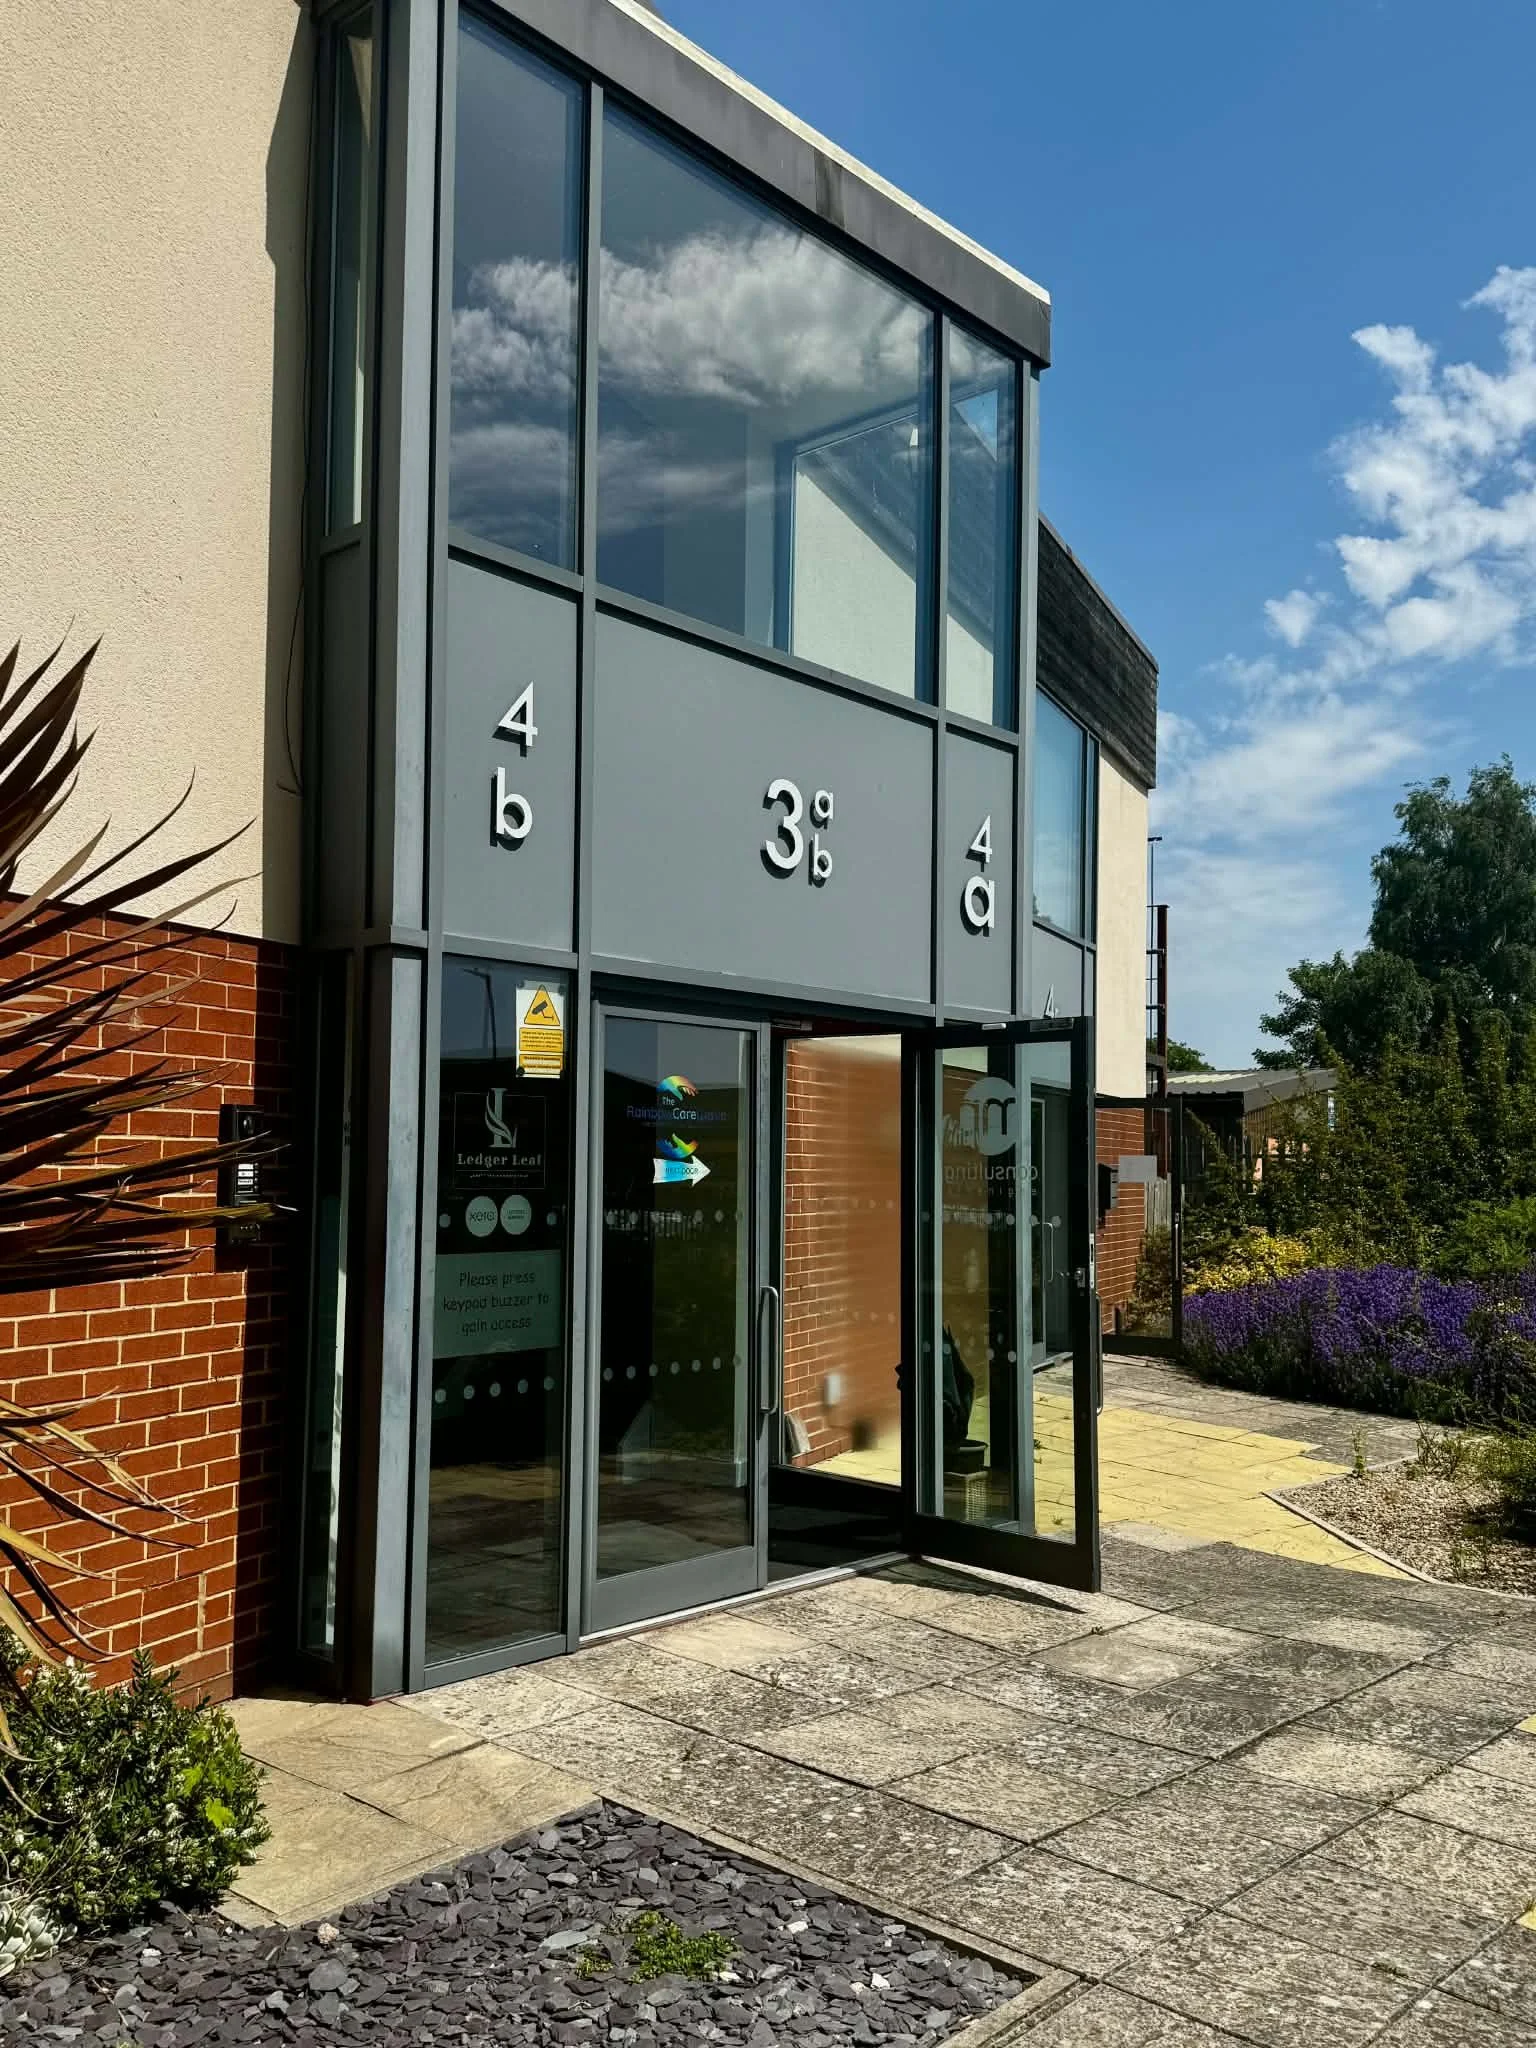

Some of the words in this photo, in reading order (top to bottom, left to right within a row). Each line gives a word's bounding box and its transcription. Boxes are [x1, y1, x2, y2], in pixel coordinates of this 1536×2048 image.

[498, 681, 538, 747] 4
[496, 766, 533, 840] b
[814, 789, 834, 822] a
[765, 778, 804, 871] 3
[969, 815, 993, 864] 4
[813, 833, 833, 880] b
[964, 875, 995, 929] a
[662, 1096, 676, 1106] The
[456, 1152, 508, 1169] Ledger
[512, 1153, 542, 1167] Leaf
[459, 1271, 498, 1288] Please
[502, 1271, 536, 1289] press
[443, 1295, 487, 1313] keypad
[491, 1295, 533, 1308] buzzer
[537, 1293, 550, 1305] to
[461, 1318, 488, 1336] gain
[490, 1318, 533, 1331] access
